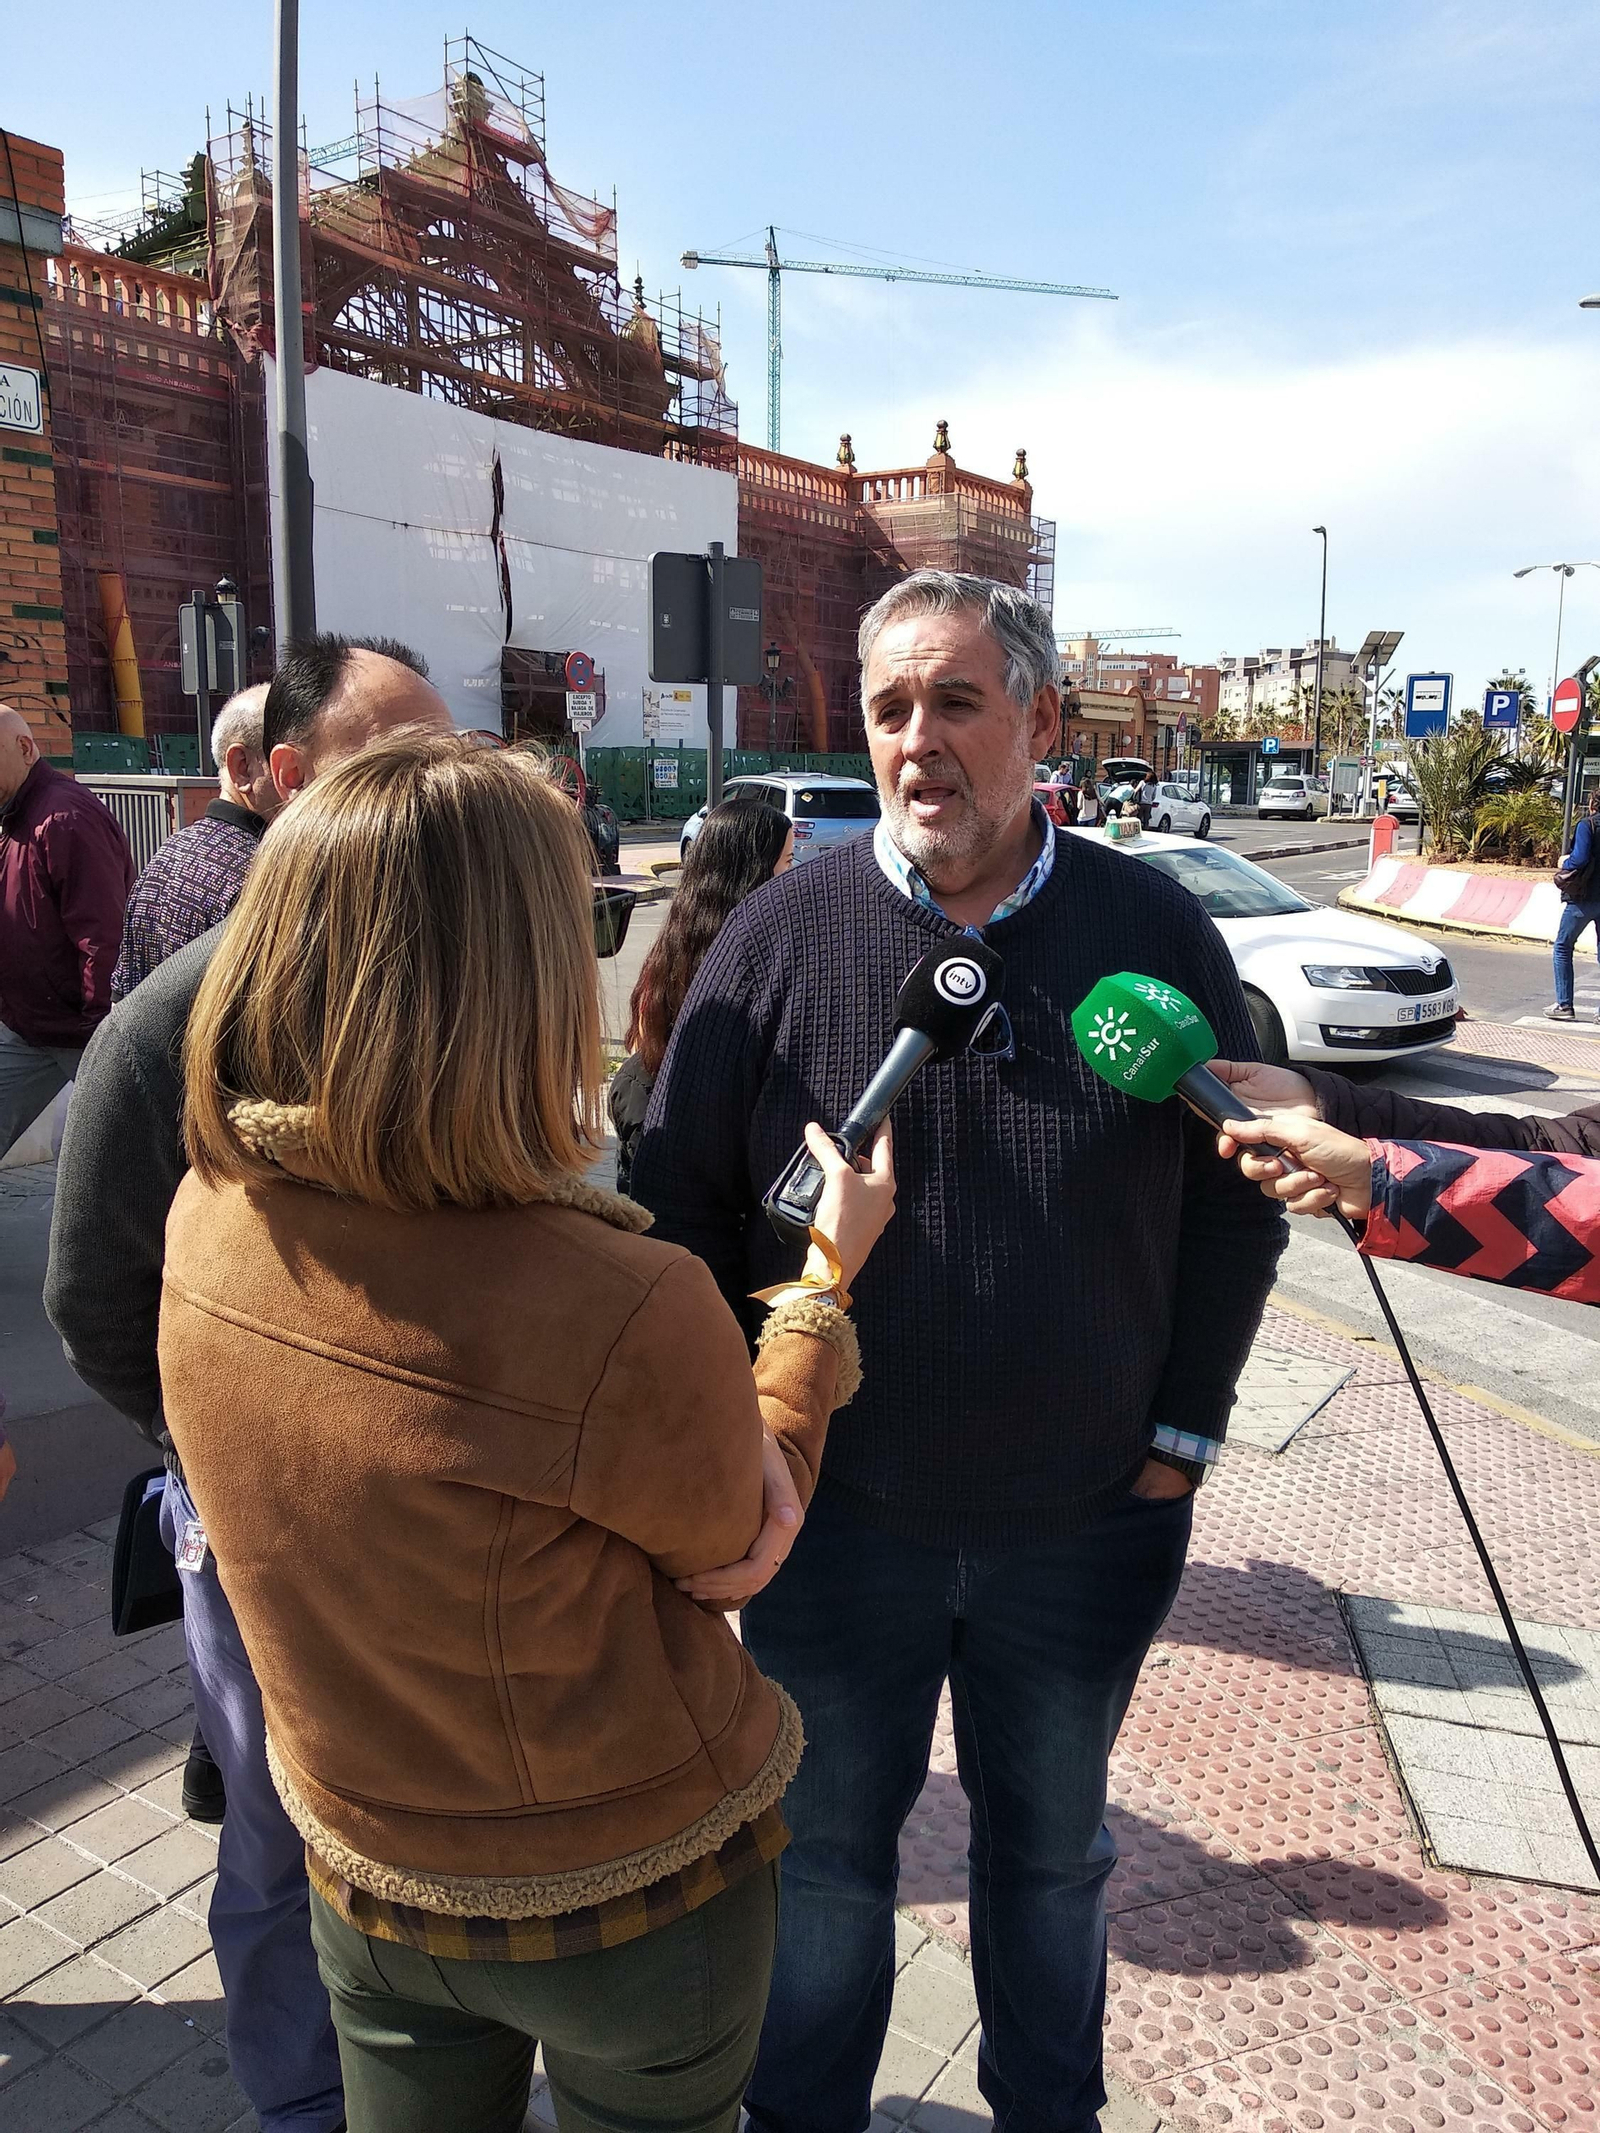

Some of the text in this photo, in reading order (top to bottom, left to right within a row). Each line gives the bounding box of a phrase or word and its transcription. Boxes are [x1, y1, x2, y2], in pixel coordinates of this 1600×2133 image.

[1491, 695, 1510, 716] P
[1265, 739, 1276, 752] P
[949, 970, 972, 989] intv
[1400, 1009, 1414, 1020] SP
[1422, 1002, 1442, 1018] 5583
